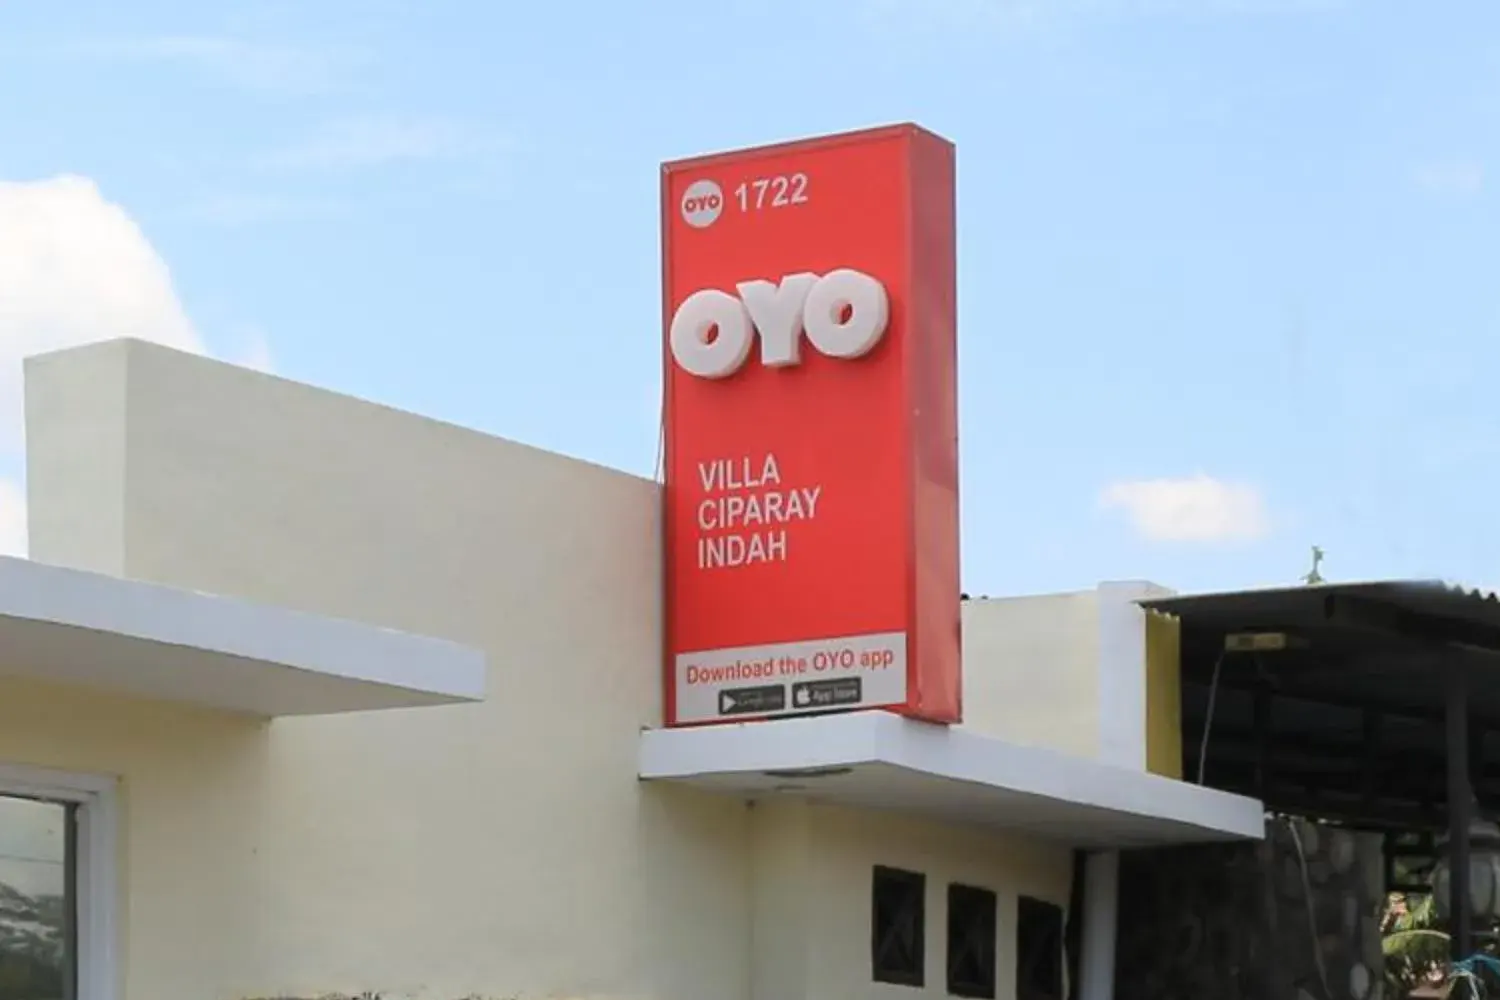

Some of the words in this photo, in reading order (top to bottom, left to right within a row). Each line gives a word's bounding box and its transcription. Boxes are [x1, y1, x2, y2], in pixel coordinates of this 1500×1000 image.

[684, 194, 720, 213] OYO
[735, 173, 808, 212] 1722
[670, 267, 889, 378] OYO
[699, 453, 780, 492] VILLA
[698, 486, 821, 530] CIPARAY
[698, 531, 786, 568] INDAH
[687, 659, 774, 684] Download
[779, 656, 807, 675] the
[813, 649, 854, 671] OYO
[860, 650, 893, 670] app
